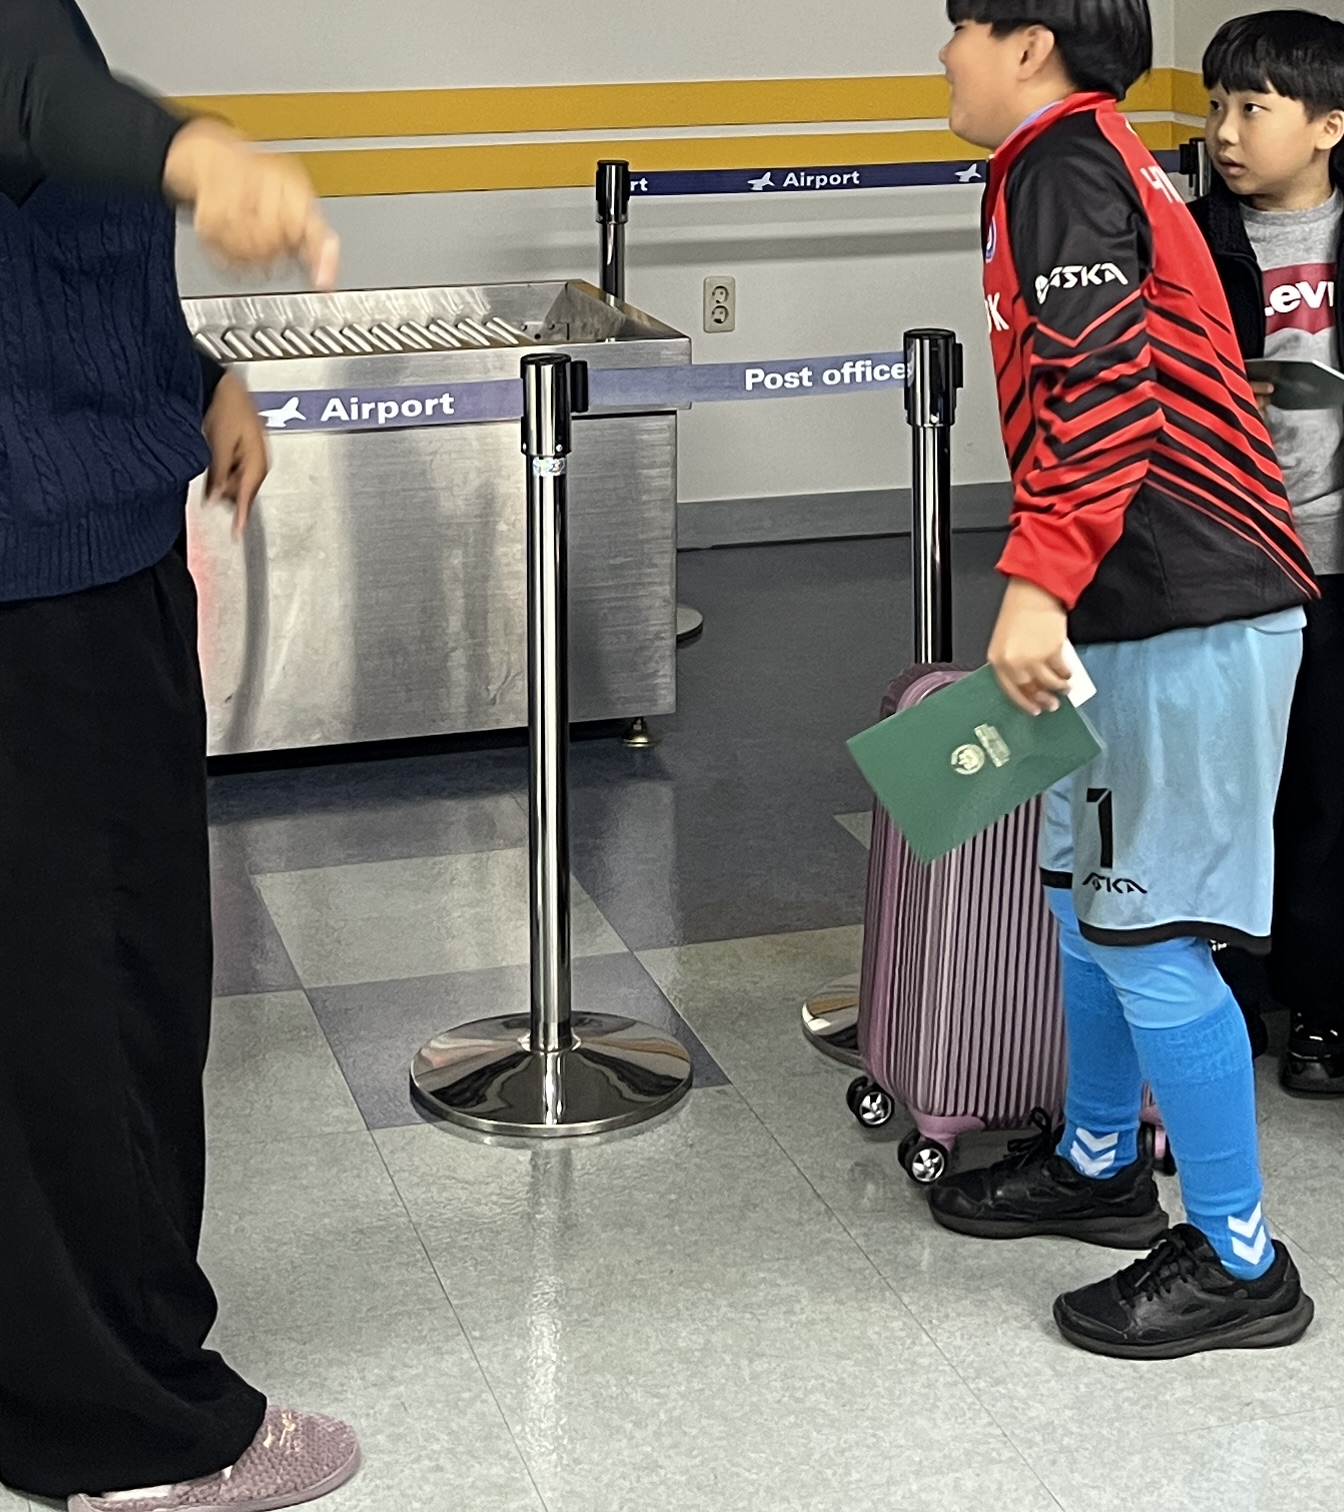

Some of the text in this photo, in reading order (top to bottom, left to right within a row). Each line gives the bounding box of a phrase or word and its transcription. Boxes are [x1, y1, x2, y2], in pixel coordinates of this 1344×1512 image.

[783, 171, 860, 189] Airport
[744, 360, 906, 390] Post office
[319, 392, 454, 425] Airport
[1086, 788, 1113, 868] 1
